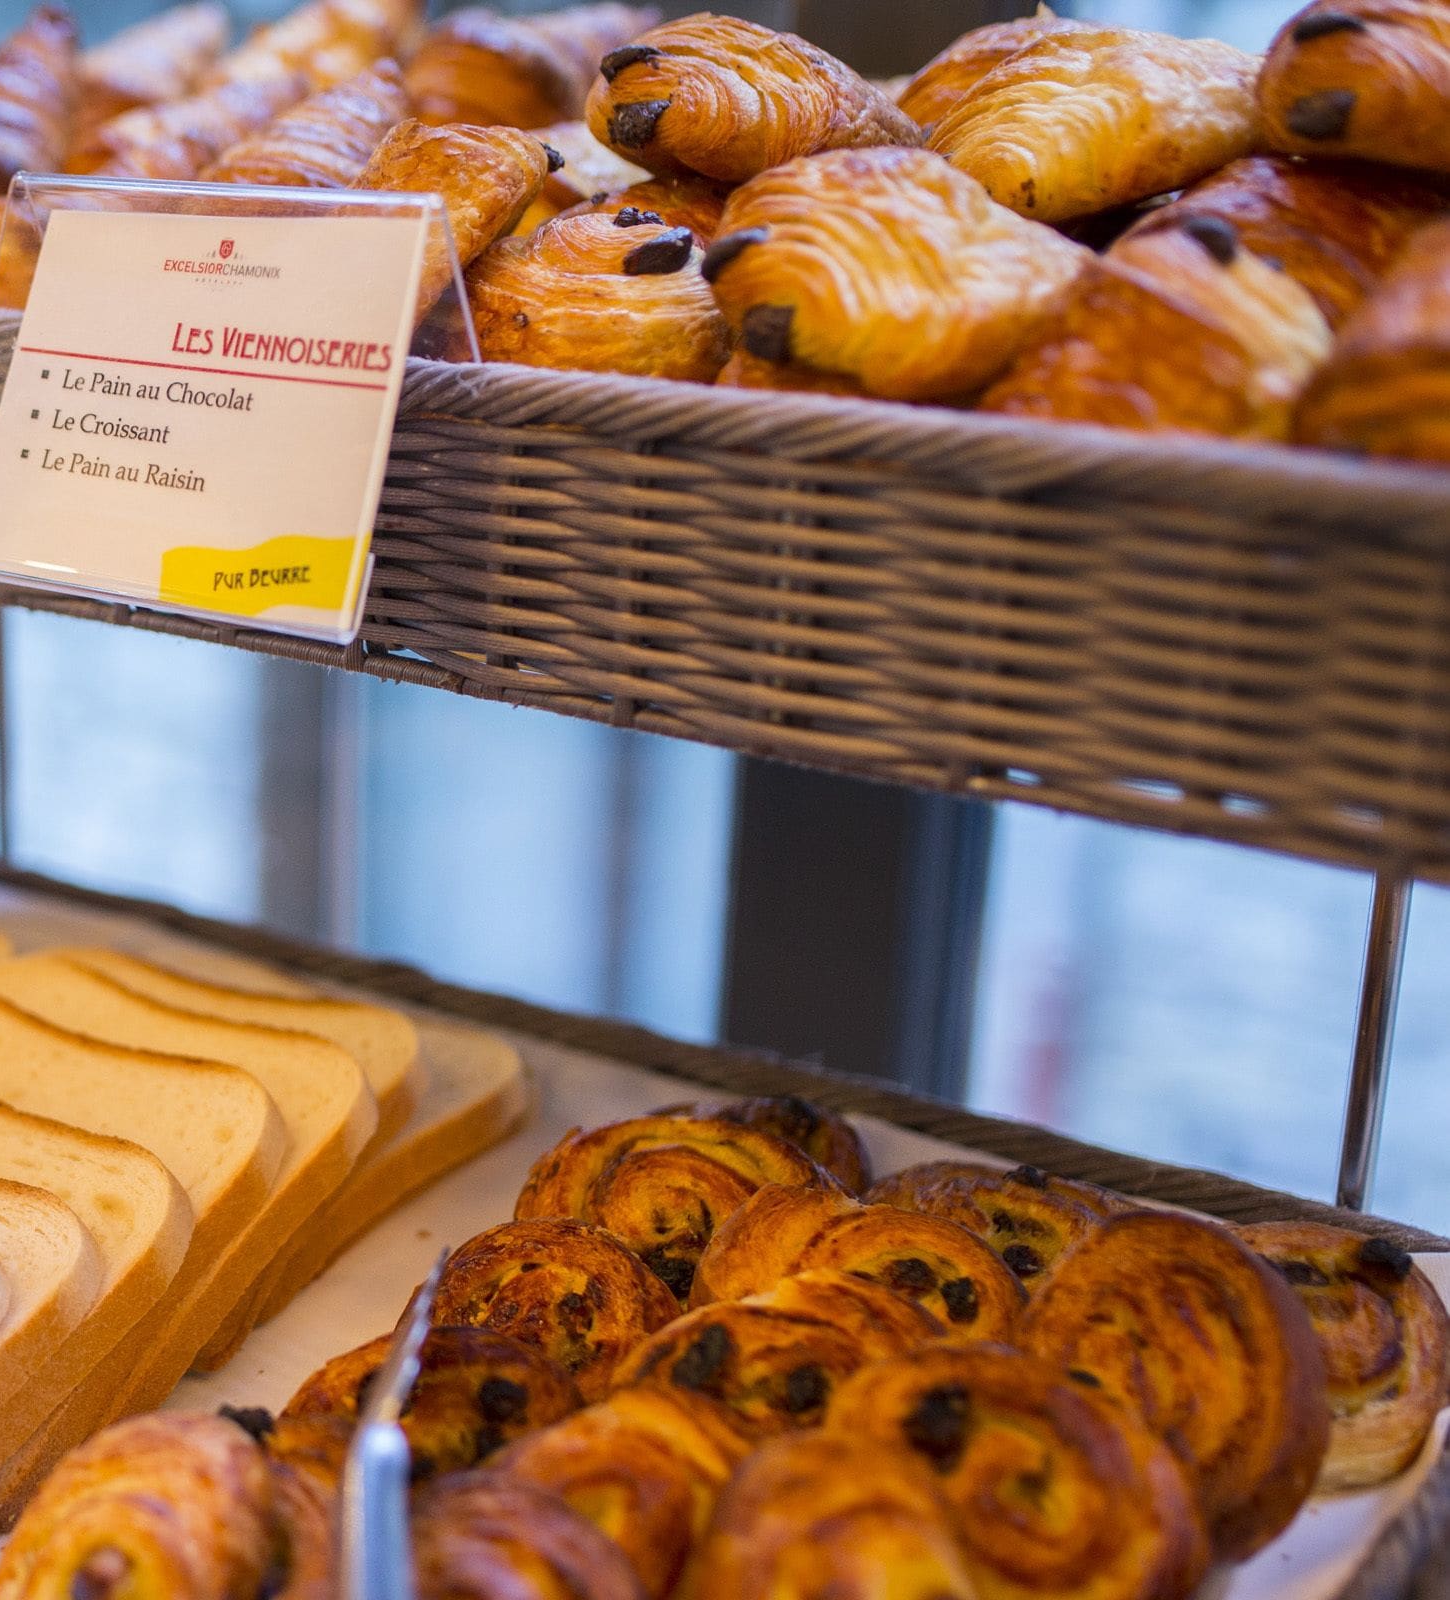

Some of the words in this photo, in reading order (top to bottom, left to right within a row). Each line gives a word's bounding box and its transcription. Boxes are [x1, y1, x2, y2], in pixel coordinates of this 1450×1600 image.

[172, 322, 214, 355] LES
[221, 326, 392, 372] VIENNOISERIES
[62, 369, 85, 391] Le
[89, 372, 131, 397] Pain
[136, 385, 160, 400] au
[166, 381, 254, 411] Chocolat
[52, 409, 75, 431] Le
[80, 413, 171, 444] Croissant
[41, 449, 65, 471] Le
[68, 453, 110, 478] Pain
[115, 465, 140, 482] au
[144, 463, 206, 492] Raisin
[213, 572, 244, 592] PUR
[249, 566, 311, 588] BEURRE
